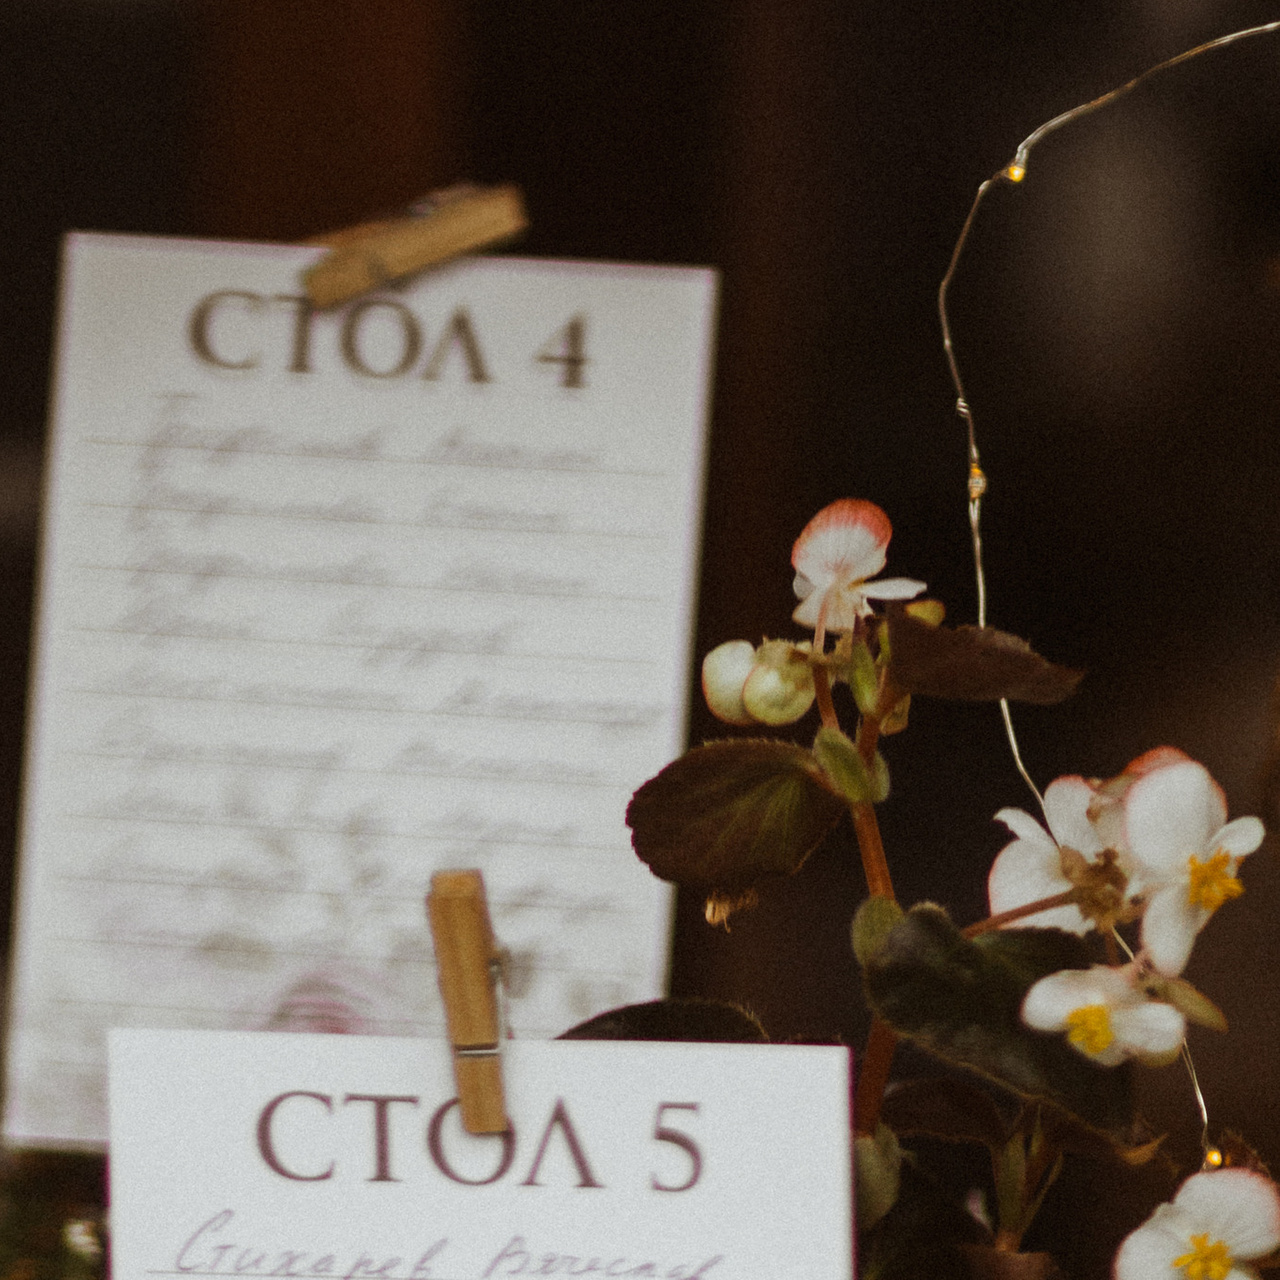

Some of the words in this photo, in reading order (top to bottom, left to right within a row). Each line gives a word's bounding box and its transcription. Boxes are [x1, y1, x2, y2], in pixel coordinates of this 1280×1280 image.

[185, 287, 494, 388] СТОЛ
[531, 309, 592, 392] 4
[254, 1088, 606, 1192] СТОЛ
[649, 1101, 706, 1194] 5
